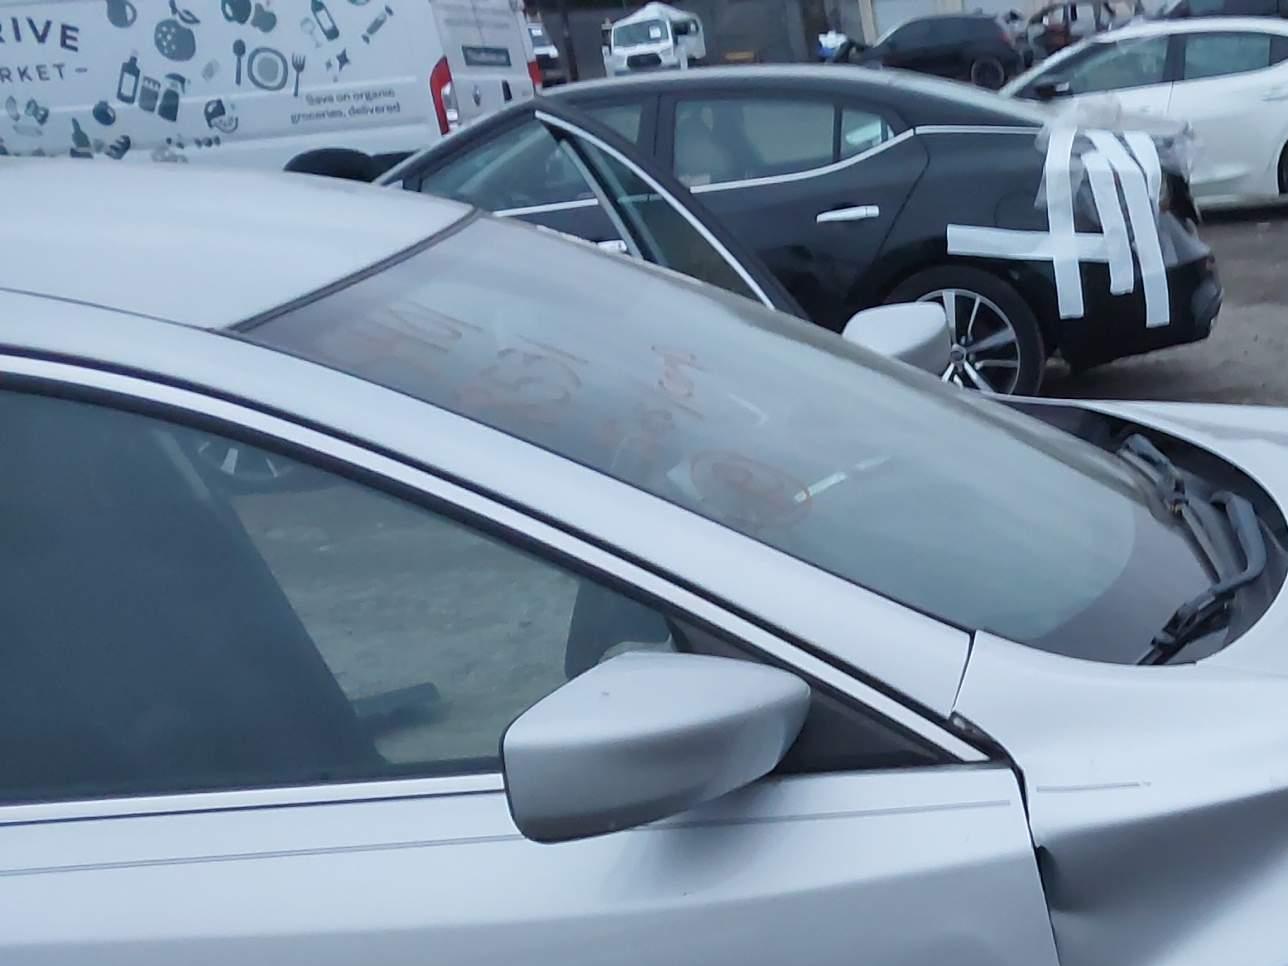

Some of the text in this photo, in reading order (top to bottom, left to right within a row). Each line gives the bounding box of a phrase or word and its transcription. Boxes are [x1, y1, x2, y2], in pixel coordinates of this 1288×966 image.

[0, 16, 80, 53] IVE
[305, 88, 395, 106] Save on organic
[348, 100, 400, 116] delivered
